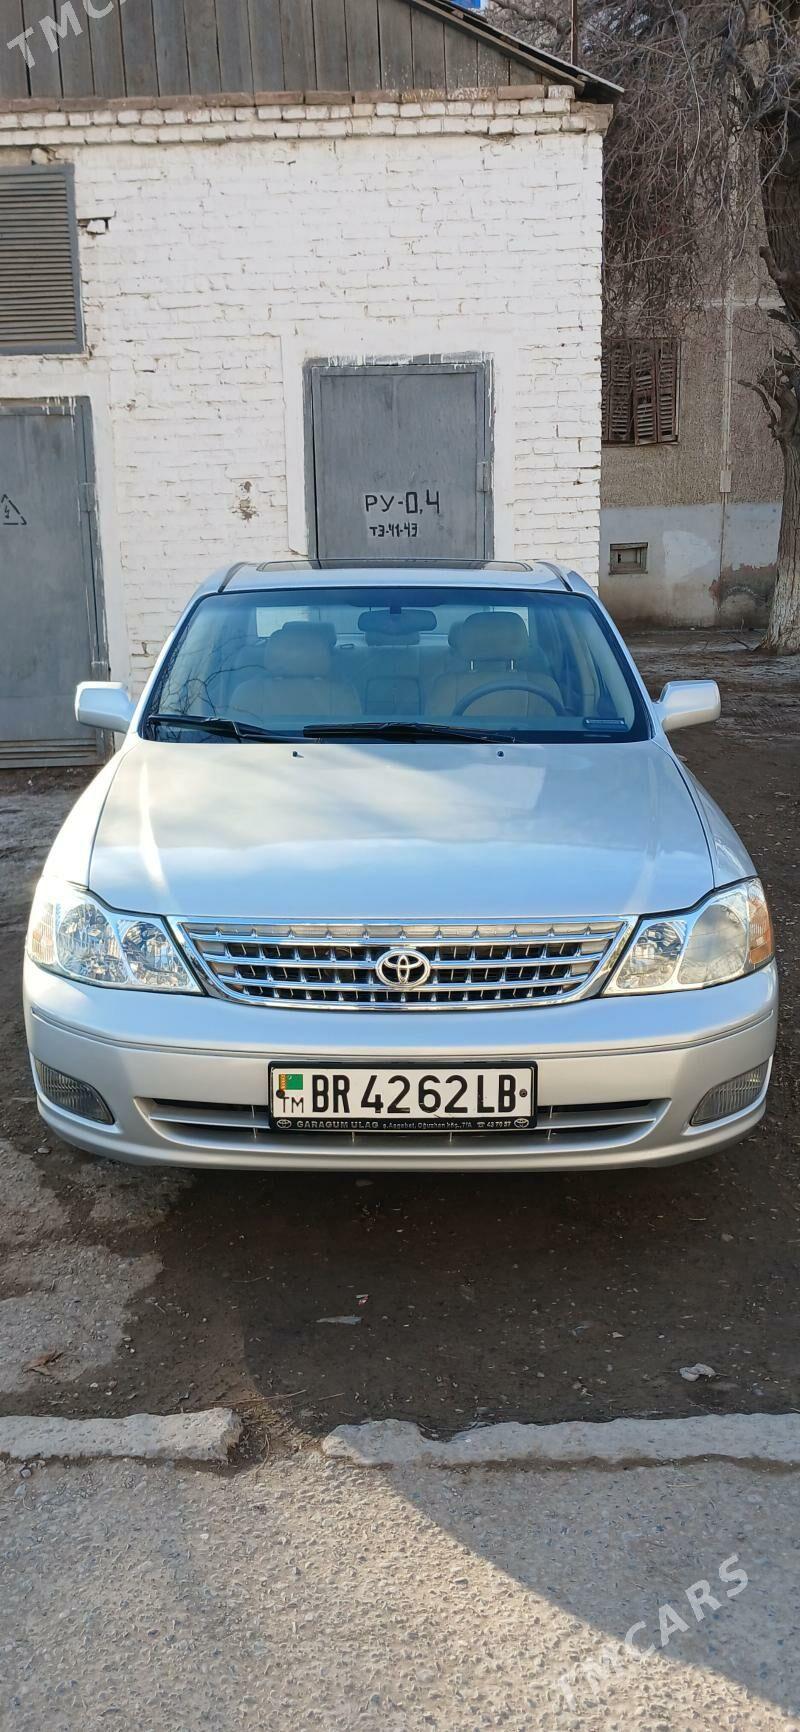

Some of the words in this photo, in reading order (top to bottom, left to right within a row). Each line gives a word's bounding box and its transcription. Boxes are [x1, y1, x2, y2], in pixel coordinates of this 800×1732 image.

[311, 1074, 351, 1114] BR
[360, 1074, 469, 1114] 4262
[476, 1074, 517, 1114] LB
[280, 1097, 305, 1114] TM
[296, 1120, 349, 1129] GARAGUM
